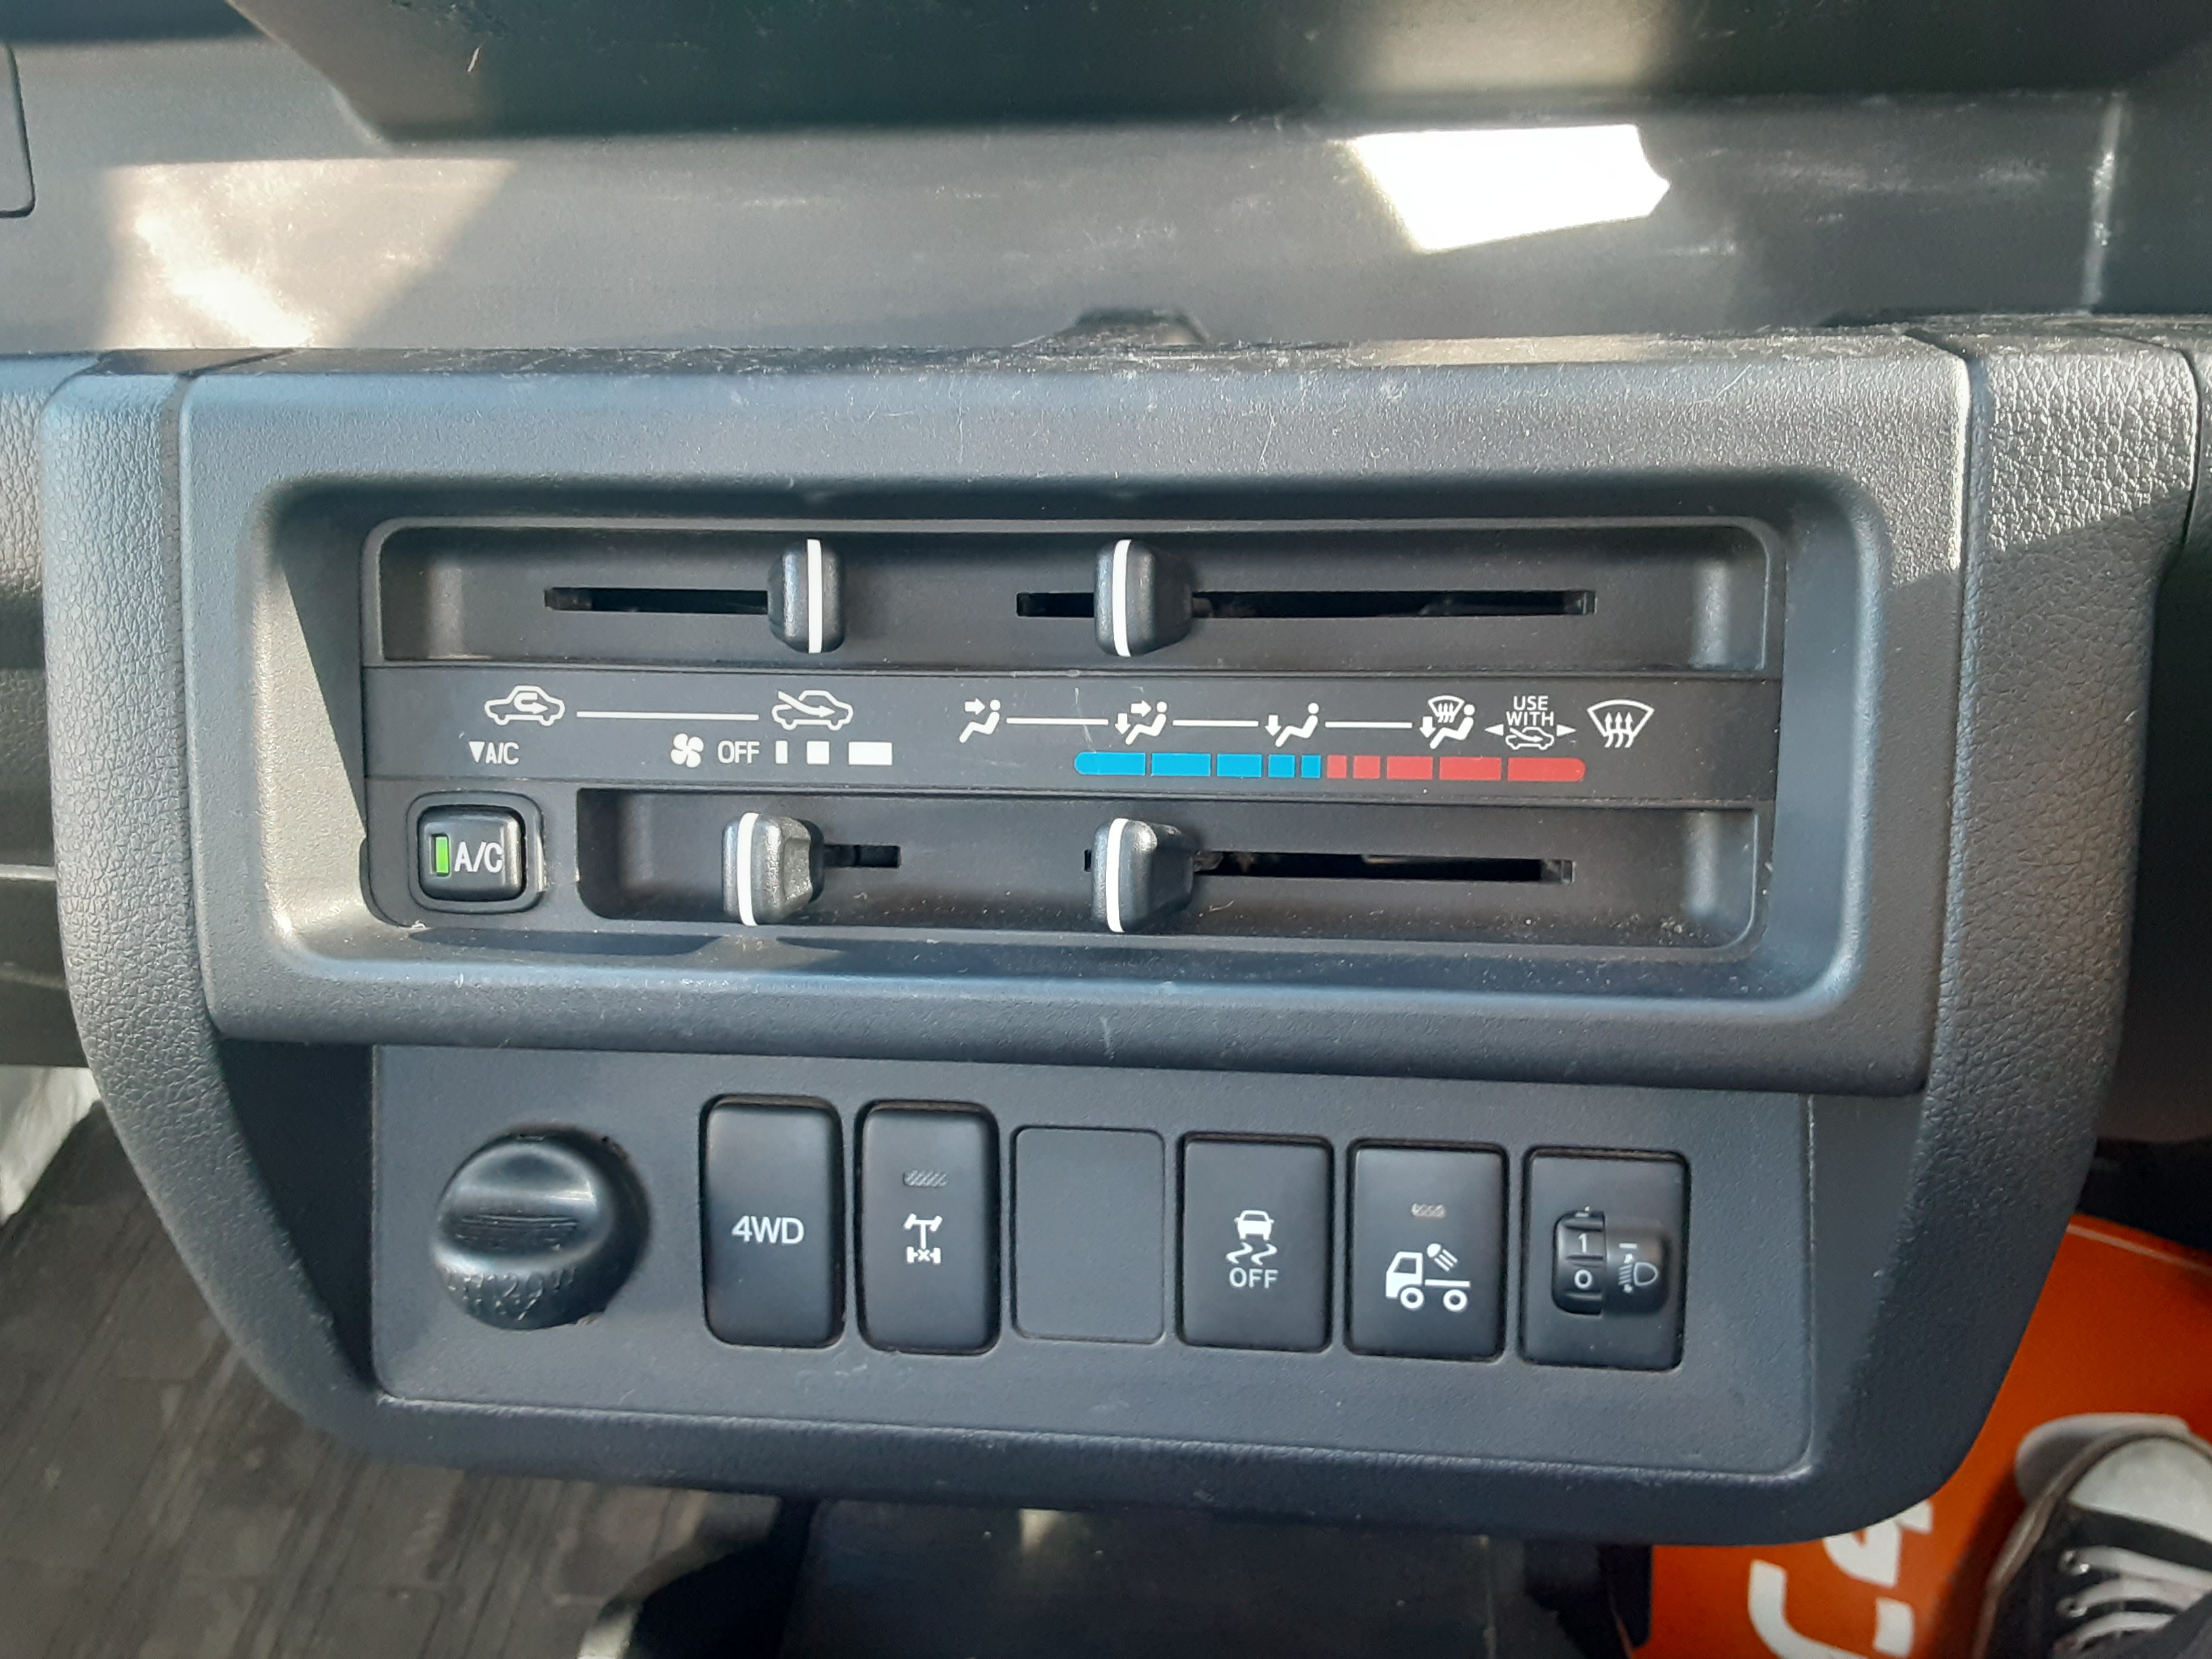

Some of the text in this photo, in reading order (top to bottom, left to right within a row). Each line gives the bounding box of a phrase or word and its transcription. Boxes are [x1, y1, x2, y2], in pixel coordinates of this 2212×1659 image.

[1513, 695, 1549, 711] USE
[1506, 711, 1555, 726] WITH
[717, 740, 760, 764] OFF
[453, 840, 503, 874] A/C
[731, 1215, 805, 1246] 4WD
[1228, 1266, 1279, 1289] OFF
